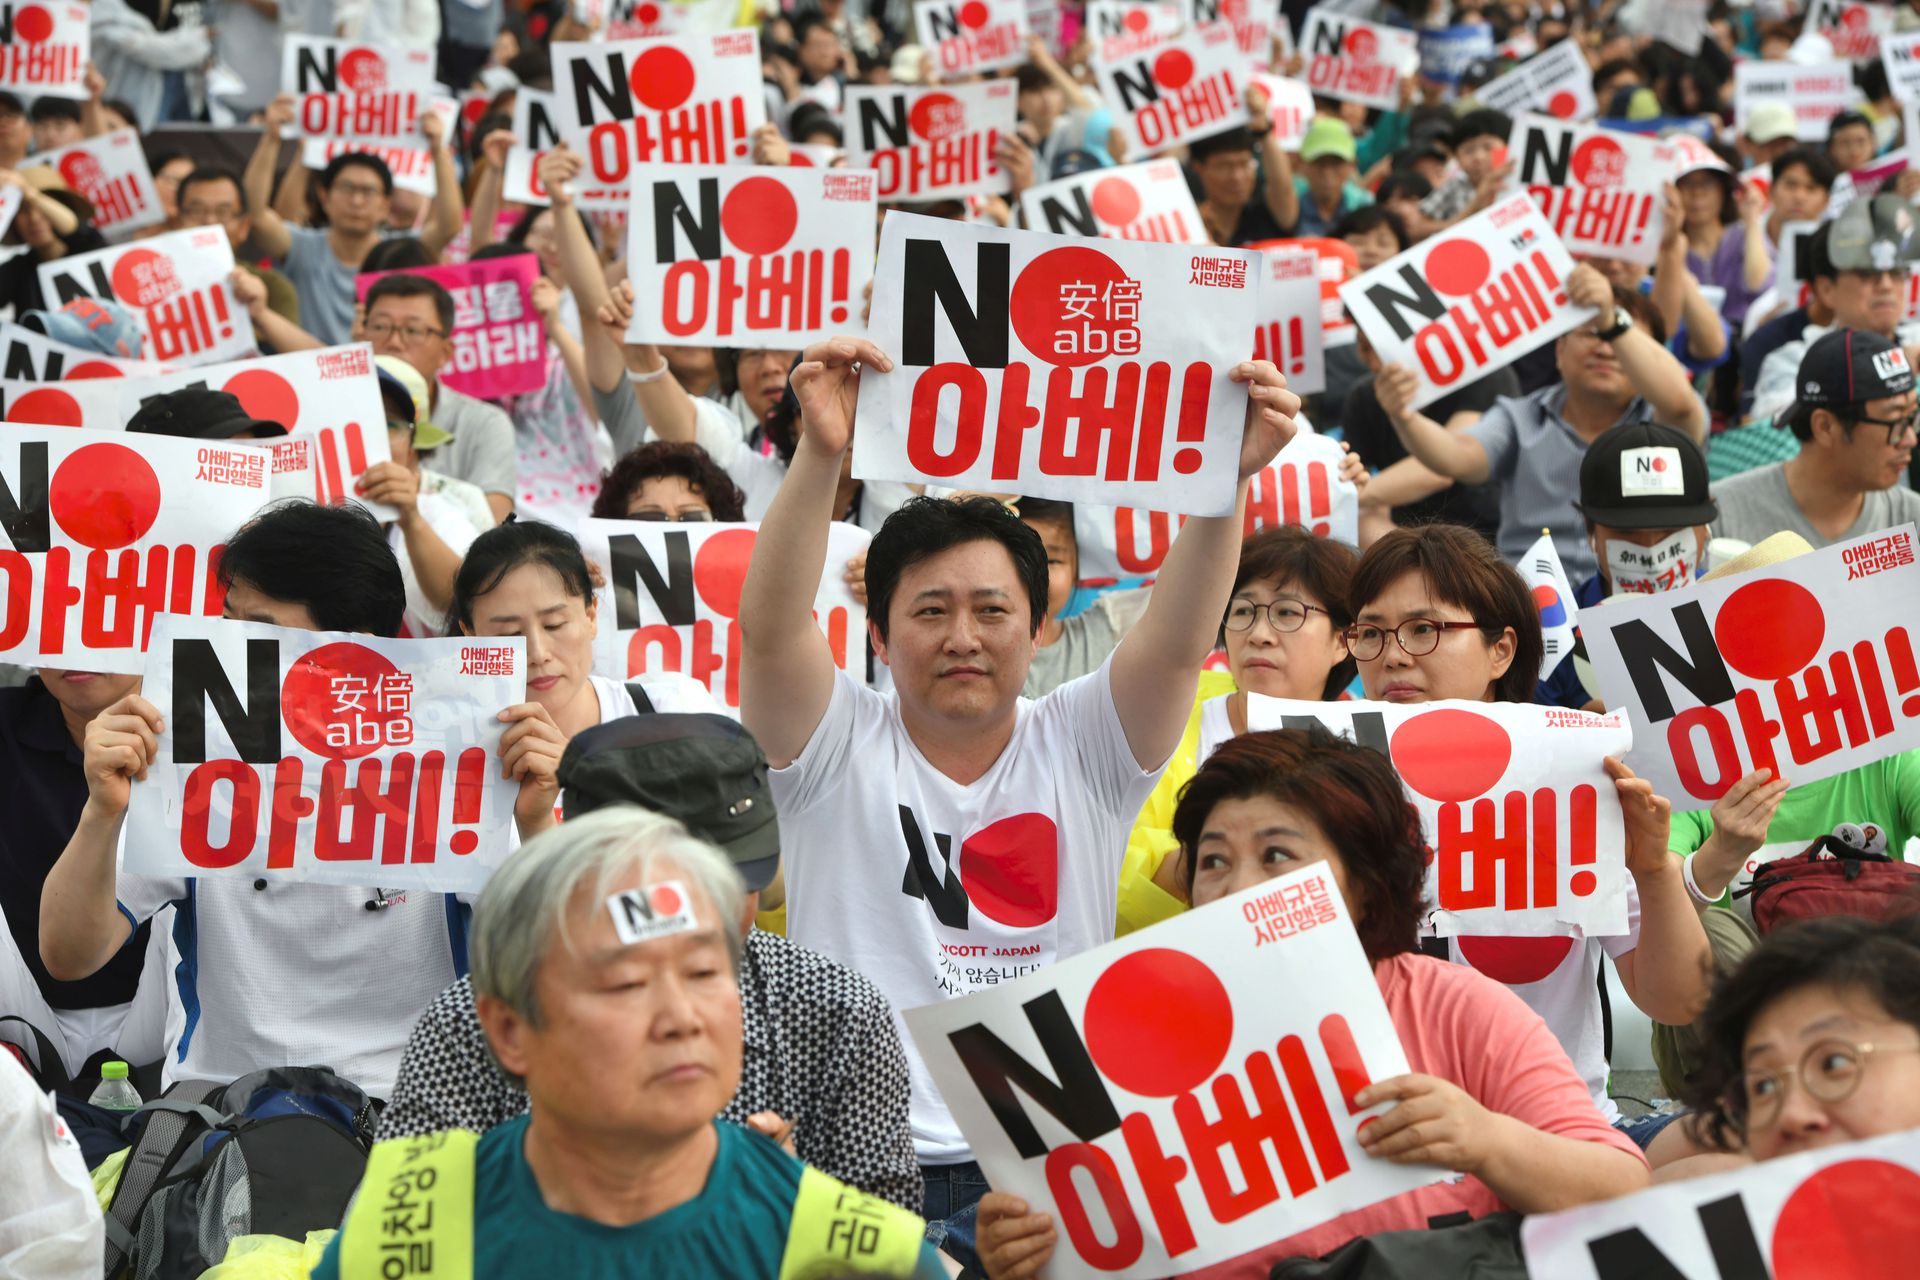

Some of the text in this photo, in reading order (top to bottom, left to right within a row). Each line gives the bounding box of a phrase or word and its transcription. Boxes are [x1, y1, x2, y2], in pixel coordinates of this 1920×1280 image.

[1189, 271, 1246, 289] 시민행동
[1191, 256, 1248, 274] 아베규탄
[662, 247, 850, 337] 아베!
[1059, 278, 1143, 322] 安倍
[1053, 321, 1142, 356] abe
[906, 361, 1213, 482] 아베!
[195, 466, 263, 488] 시민행동
[197, 448, 266, 471] 아베규탄
[1841, 532, 1911, 567] 아베규탄
[1847, 549, 1915, 582] 시민행동
[459, 661, 514, 676] 시민행동
[460, 647, 514, 662] 아베규탄
[331, 672, 414, 714] 安倍
[326, 714, 414, 748] abe
[1667, 626, 1920, 801] 아베!
[180, 746, 487, 869] 아베!
[1242, 875, 1326, 924] 아베규탄
[1254, 900, 1338, 947] 시민행동
[941, 943, 1040, 957] YCOTT JAPAN
[1045, 1013, 1383, 1272] 아베!
